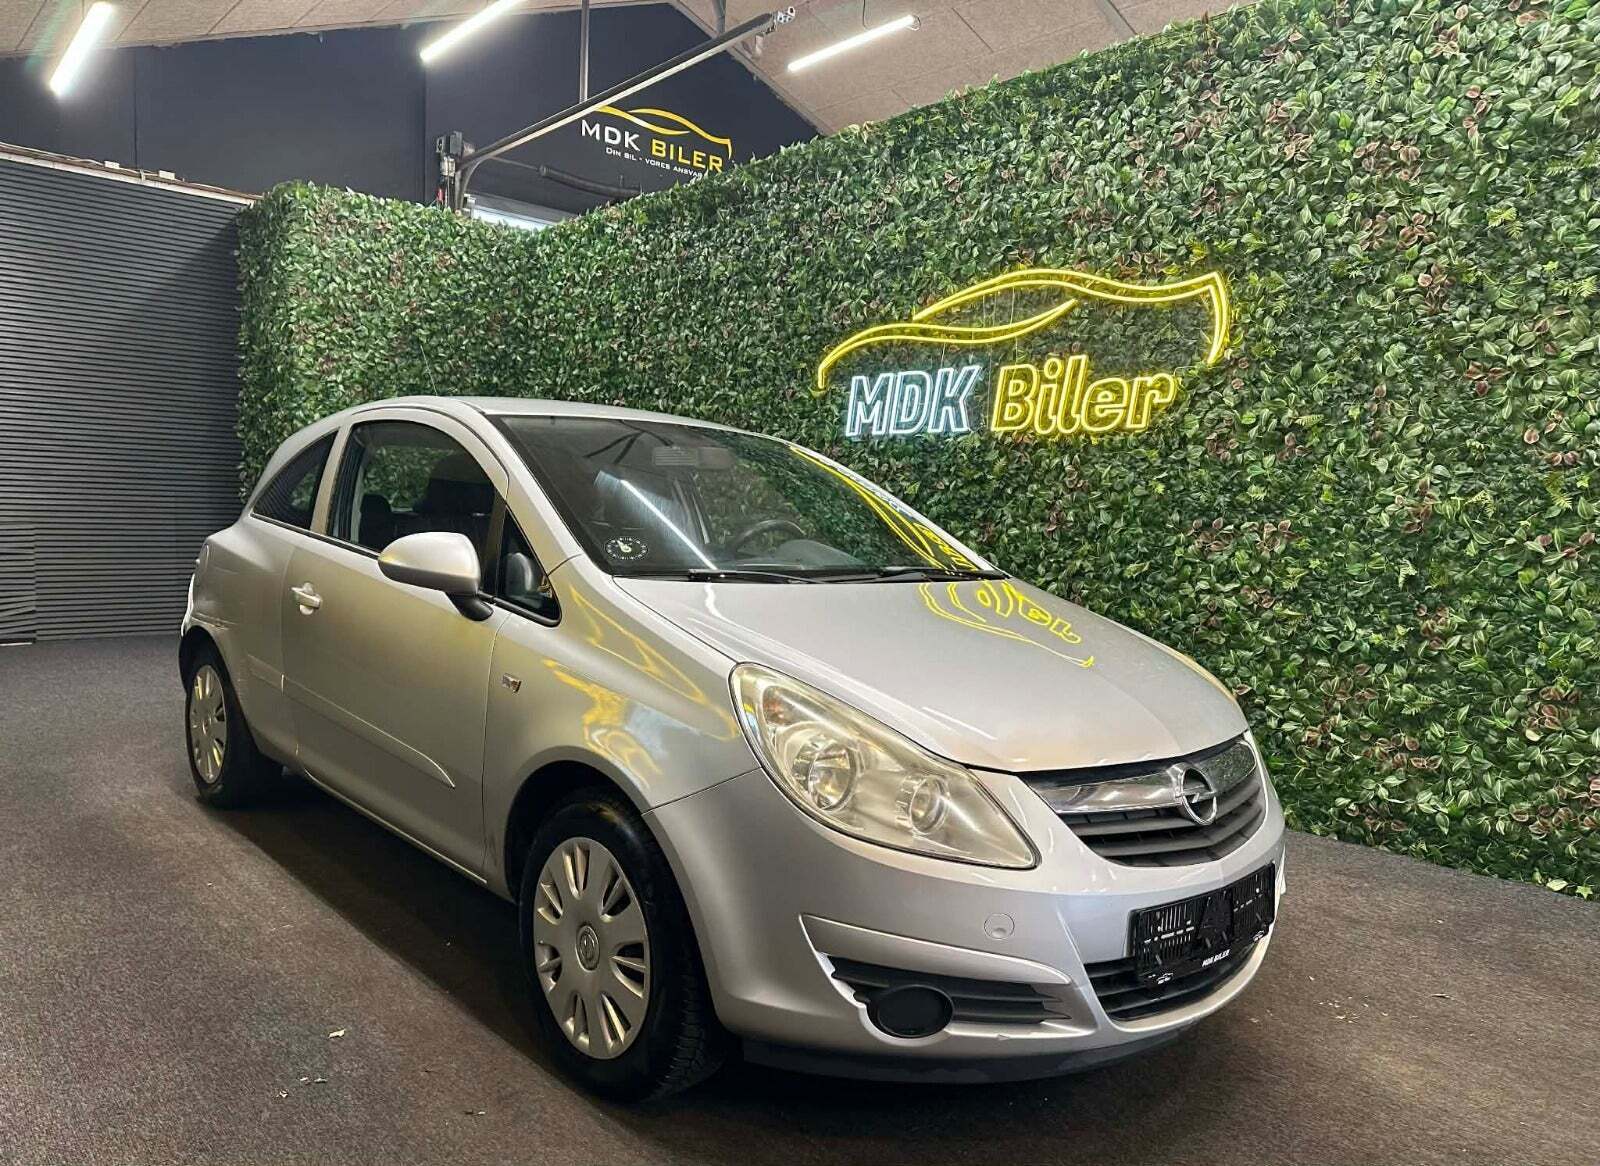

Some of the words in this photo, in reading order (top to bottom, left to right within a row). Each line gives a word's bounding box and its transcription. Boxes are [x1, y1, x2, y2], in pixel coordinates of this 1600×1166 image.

[581, 119, 641, 152] MDK
[651, 138, 723, 173] BILER
[846, 365, 982, 438] MDK
[990, 354, 1177, 436] Biler
